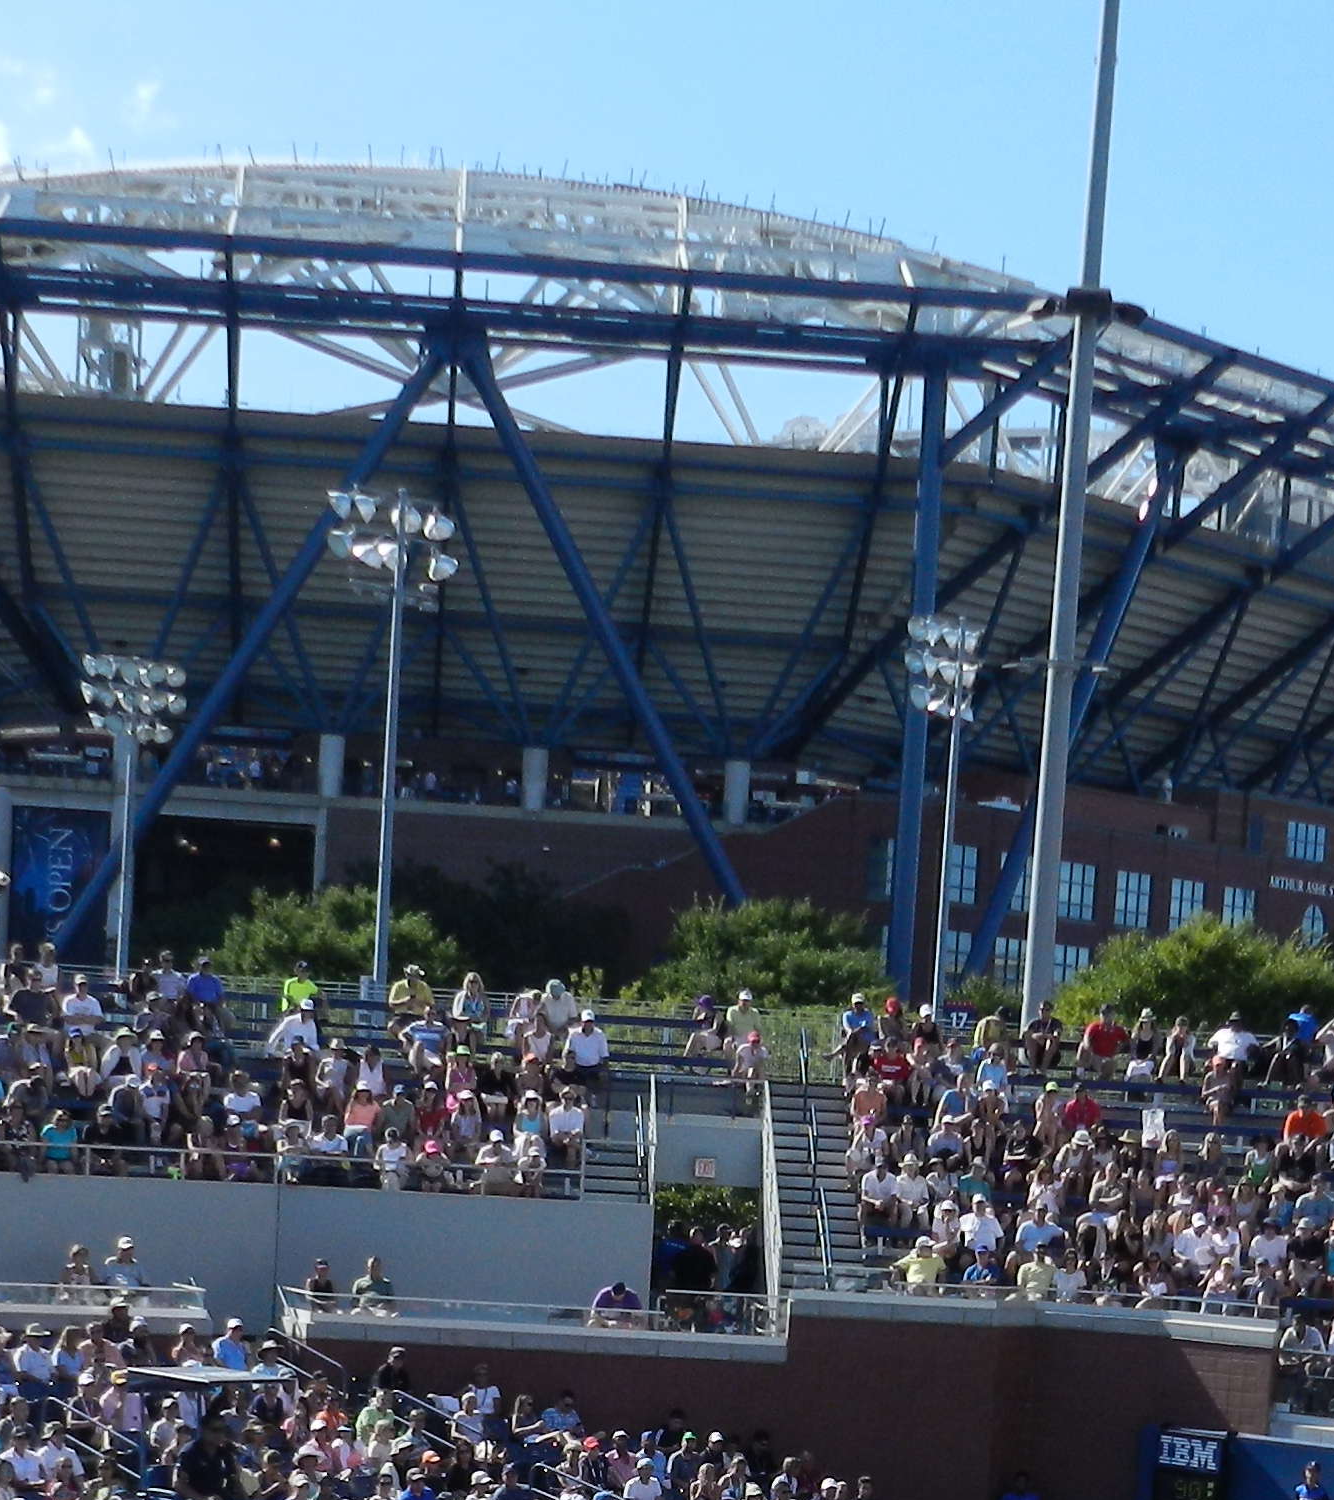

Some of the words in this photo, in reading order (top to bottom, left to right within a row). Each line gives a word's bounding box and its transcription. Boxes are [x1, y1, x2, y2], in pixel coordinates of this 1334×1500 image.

[47, 826, 74, 912] OPEN
[1269, 875, 1304, 893] ARTHUR
[1305, 881, 1327, 896] ASHE
[950, 1011, 969, 1029] 17
[1159, 1434, 1218, 1471] IBM
